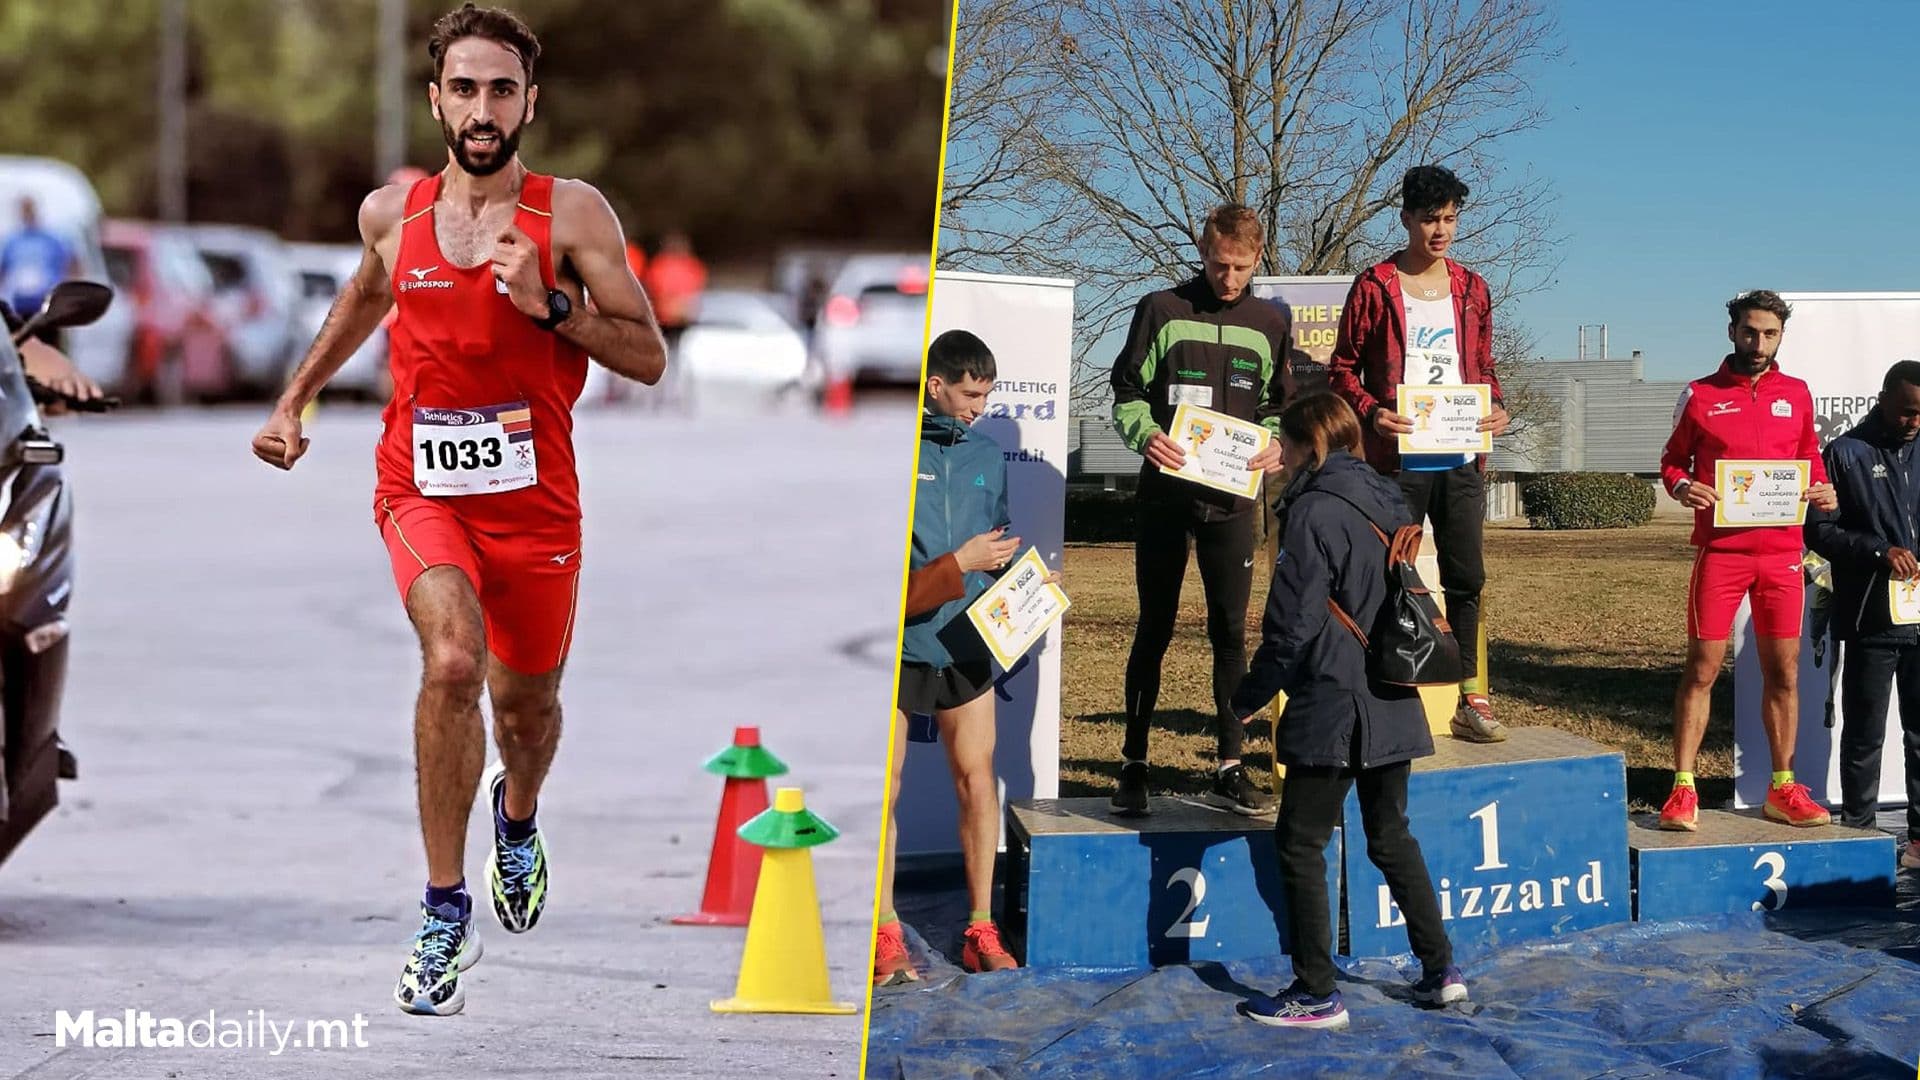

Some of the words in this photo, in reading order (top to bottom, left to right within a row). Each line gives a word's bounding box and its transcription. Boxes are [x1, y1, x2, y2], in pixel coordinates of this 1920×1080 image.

[408, 280, 455, 290] EUROSPORT
[1291, 305, 1328, 323] THE
[1428, 365, 1444, 385] 2
[993, 381, 1057, 395] ATLETICA
[1453, 398, 1477, 406] RACE
[1816, 396, 1878, 415] TERPO
[424, 409, 464, 422] Athletics
[1232, 432, 1257, 447] RACE
[419, 437, 503, 472] 1033
[1772, 472, 1797, 481] RACE
[1469, 800, 1509, 871] 1
[1752, 851, 1788, 912] 3
[1164, 867, 1211, 938] 2
